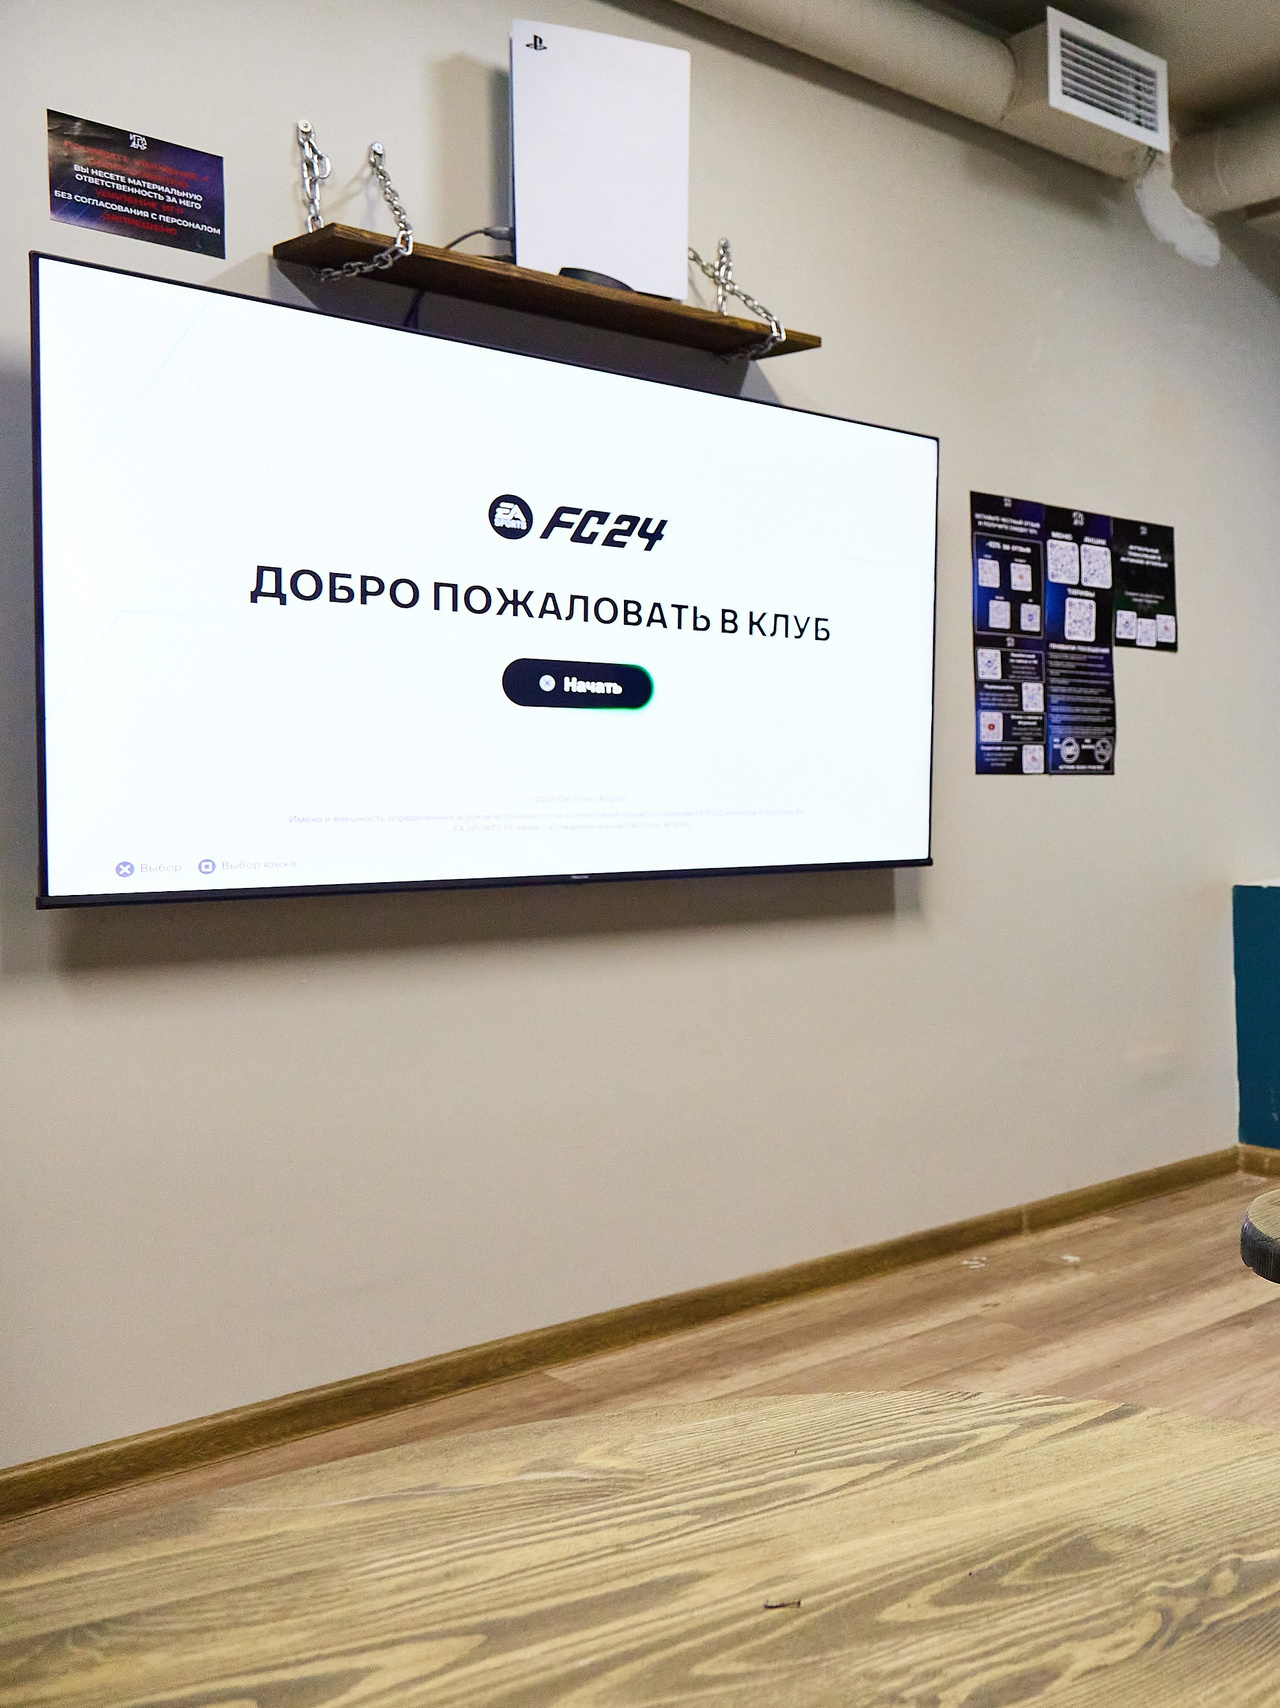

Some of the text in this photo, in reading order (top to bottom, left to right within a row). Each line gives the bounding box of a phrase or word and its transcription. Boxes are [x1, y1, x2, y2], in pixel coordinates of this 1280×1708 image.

[73, 164, 203, 202] ВЫ НЕСЕТЕ МАТЕРИАЛЬНУЮ
[75, 173, 202, 210] ОТВЕТСТВЕННОСТЬ ЗА НЕГО
[54, 189, 221, 235] БЕЗ СОГЛАСОВАНИЯ С ПЕРСОНАЛОМ
[250, 565, 831, 642] ДОБРО ПОЖАЛОВАТЬ В КЛУБ
[563, 676, 623, 695] Начать
[140, 863, 182, 874] Выбор
[221, 860, 260, 872] Выбор
